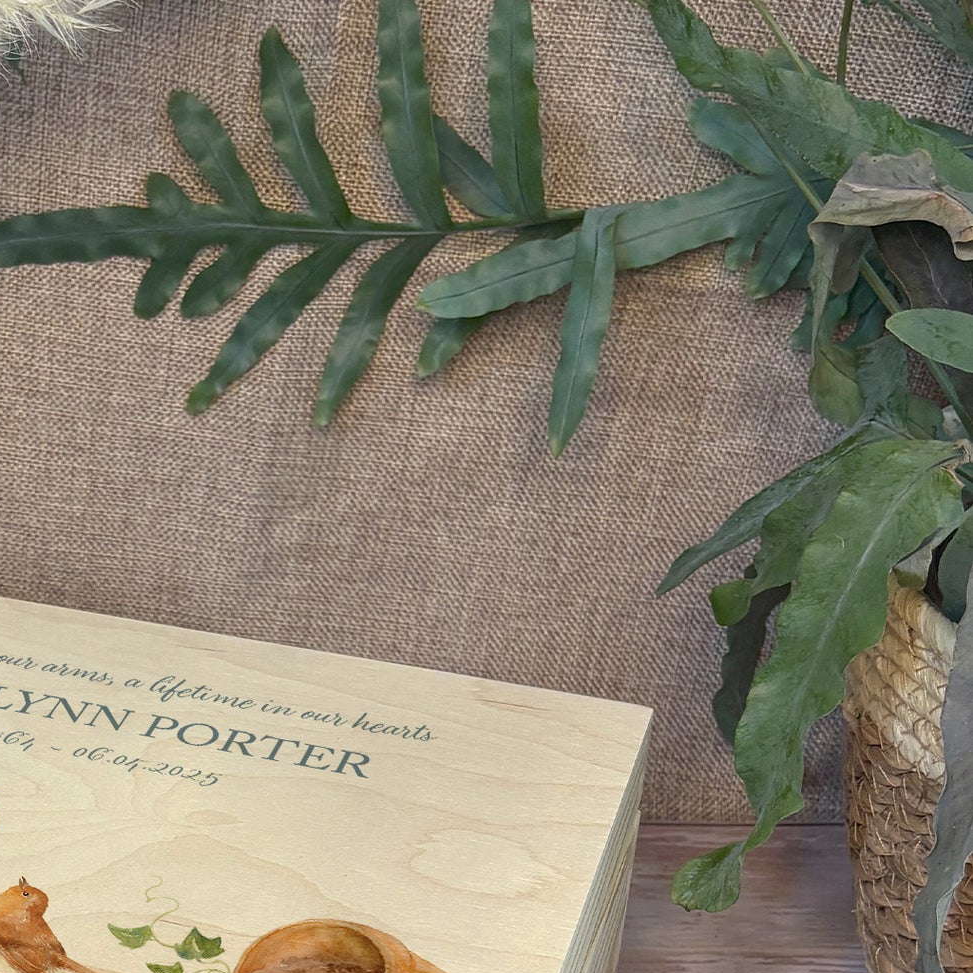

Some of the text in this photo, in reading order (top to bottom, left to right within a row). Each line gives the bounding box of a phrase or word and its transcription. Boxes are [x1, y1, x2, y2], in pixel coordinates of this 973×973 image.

[41, 662, 114, 686] arms,
[124, 678, 143, 688] a
[149, 675, 257, 711] lifetime
[261, 699, 296, 717] in
[300, 710, 348, 727] our
[351, 712, 438, 742] hearts
[72, 746, 222, 787] 06.04.2025
[139, 714, 371, 779] PORTER
